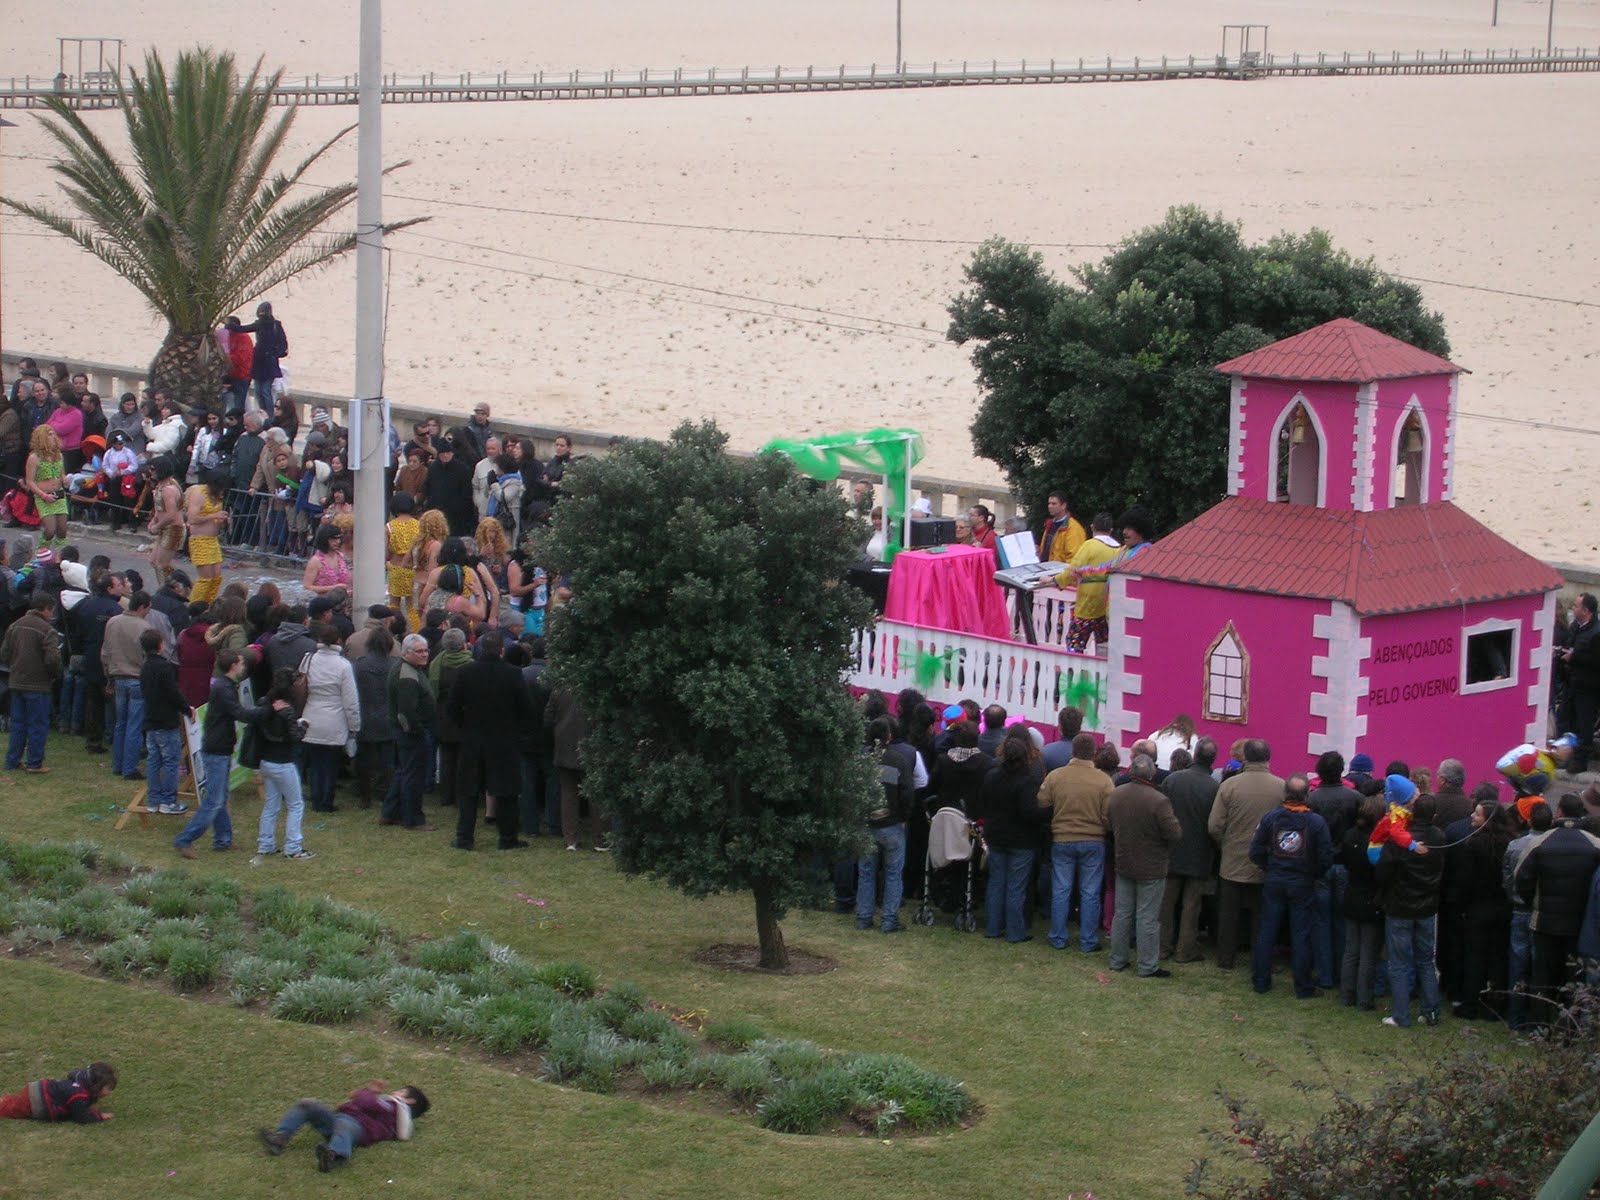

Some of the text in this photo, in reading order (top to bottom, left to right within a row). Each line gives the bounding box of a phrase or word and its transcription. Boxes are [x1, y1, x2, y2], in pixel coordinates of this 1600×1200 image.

[1374, 638, 1453, 664] ABENÇOADOS
[1369, 676, 1458, 706] PELO GOVERNO
